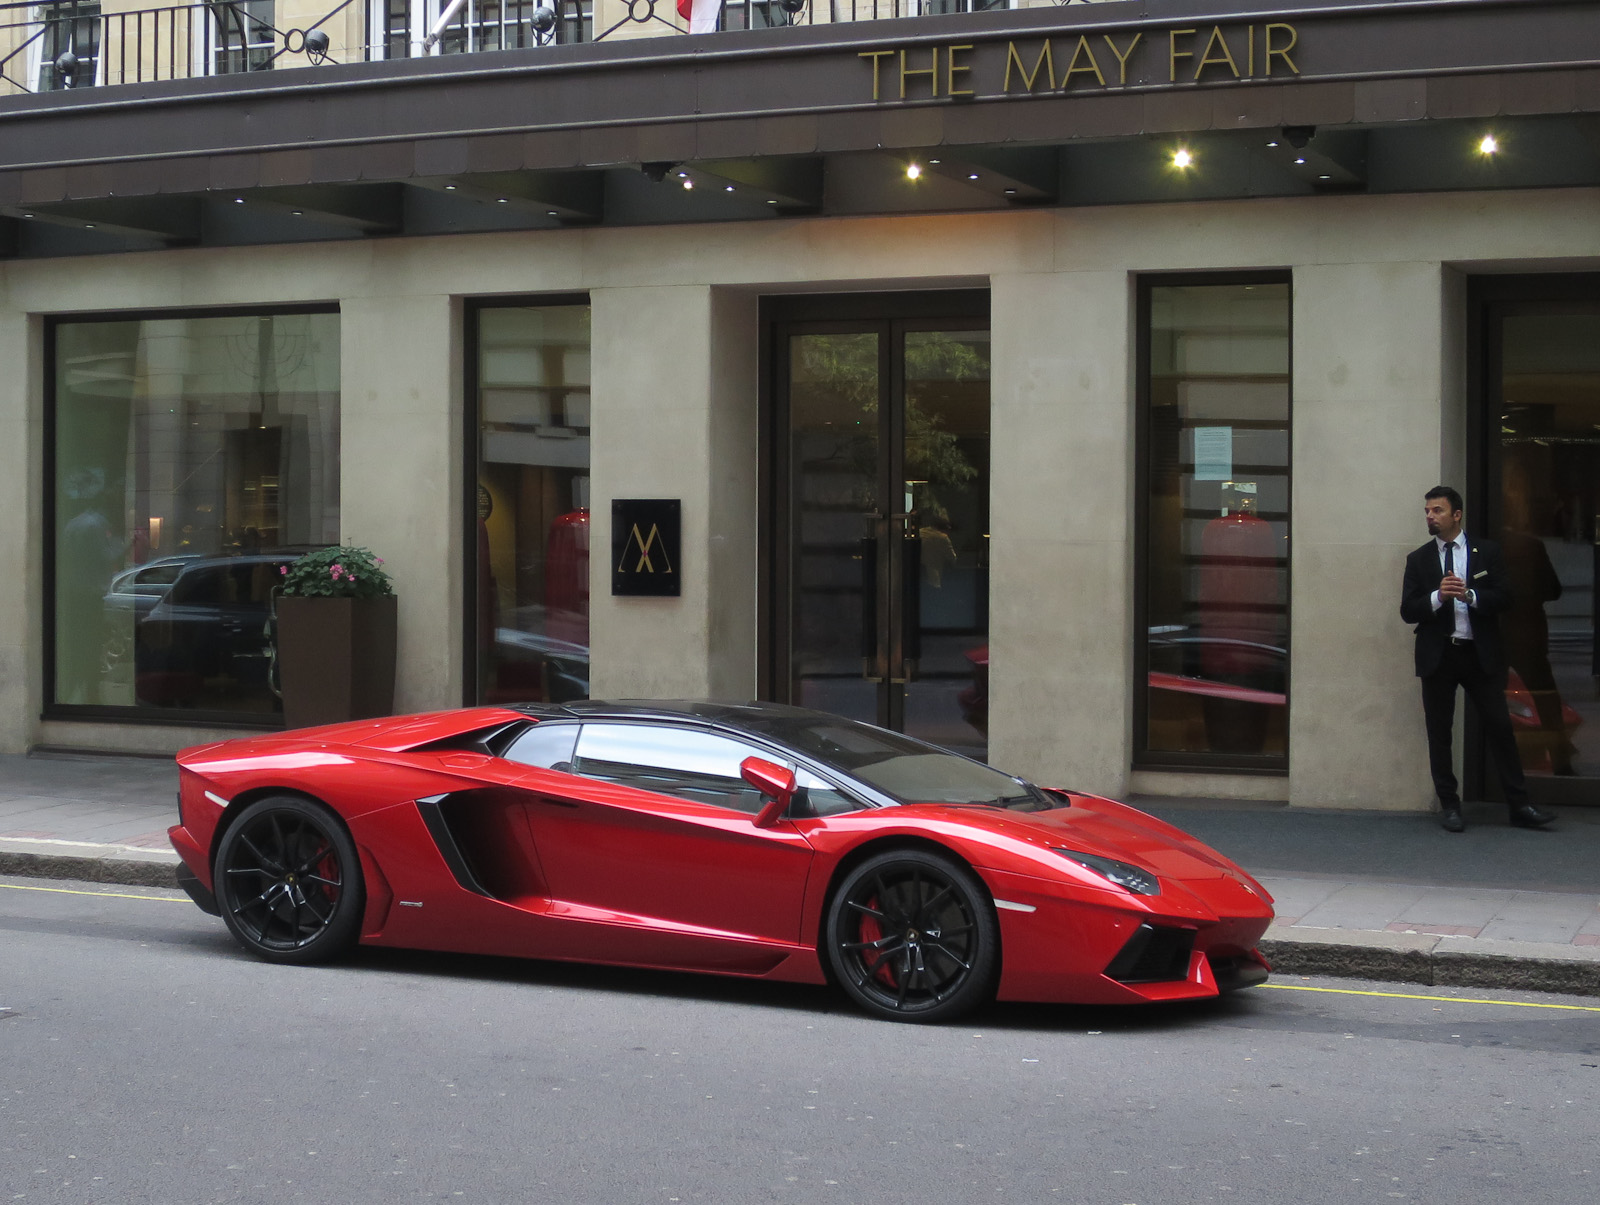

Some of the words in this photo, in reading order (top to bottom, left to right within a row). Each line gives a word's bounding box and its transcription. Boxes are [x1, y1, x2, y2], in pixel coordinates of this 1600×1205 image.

[857, 44, 974, 100] THE
[1003, 32, 1142, 92] MAY
[1169, 23, 1300, 82] FAIR
